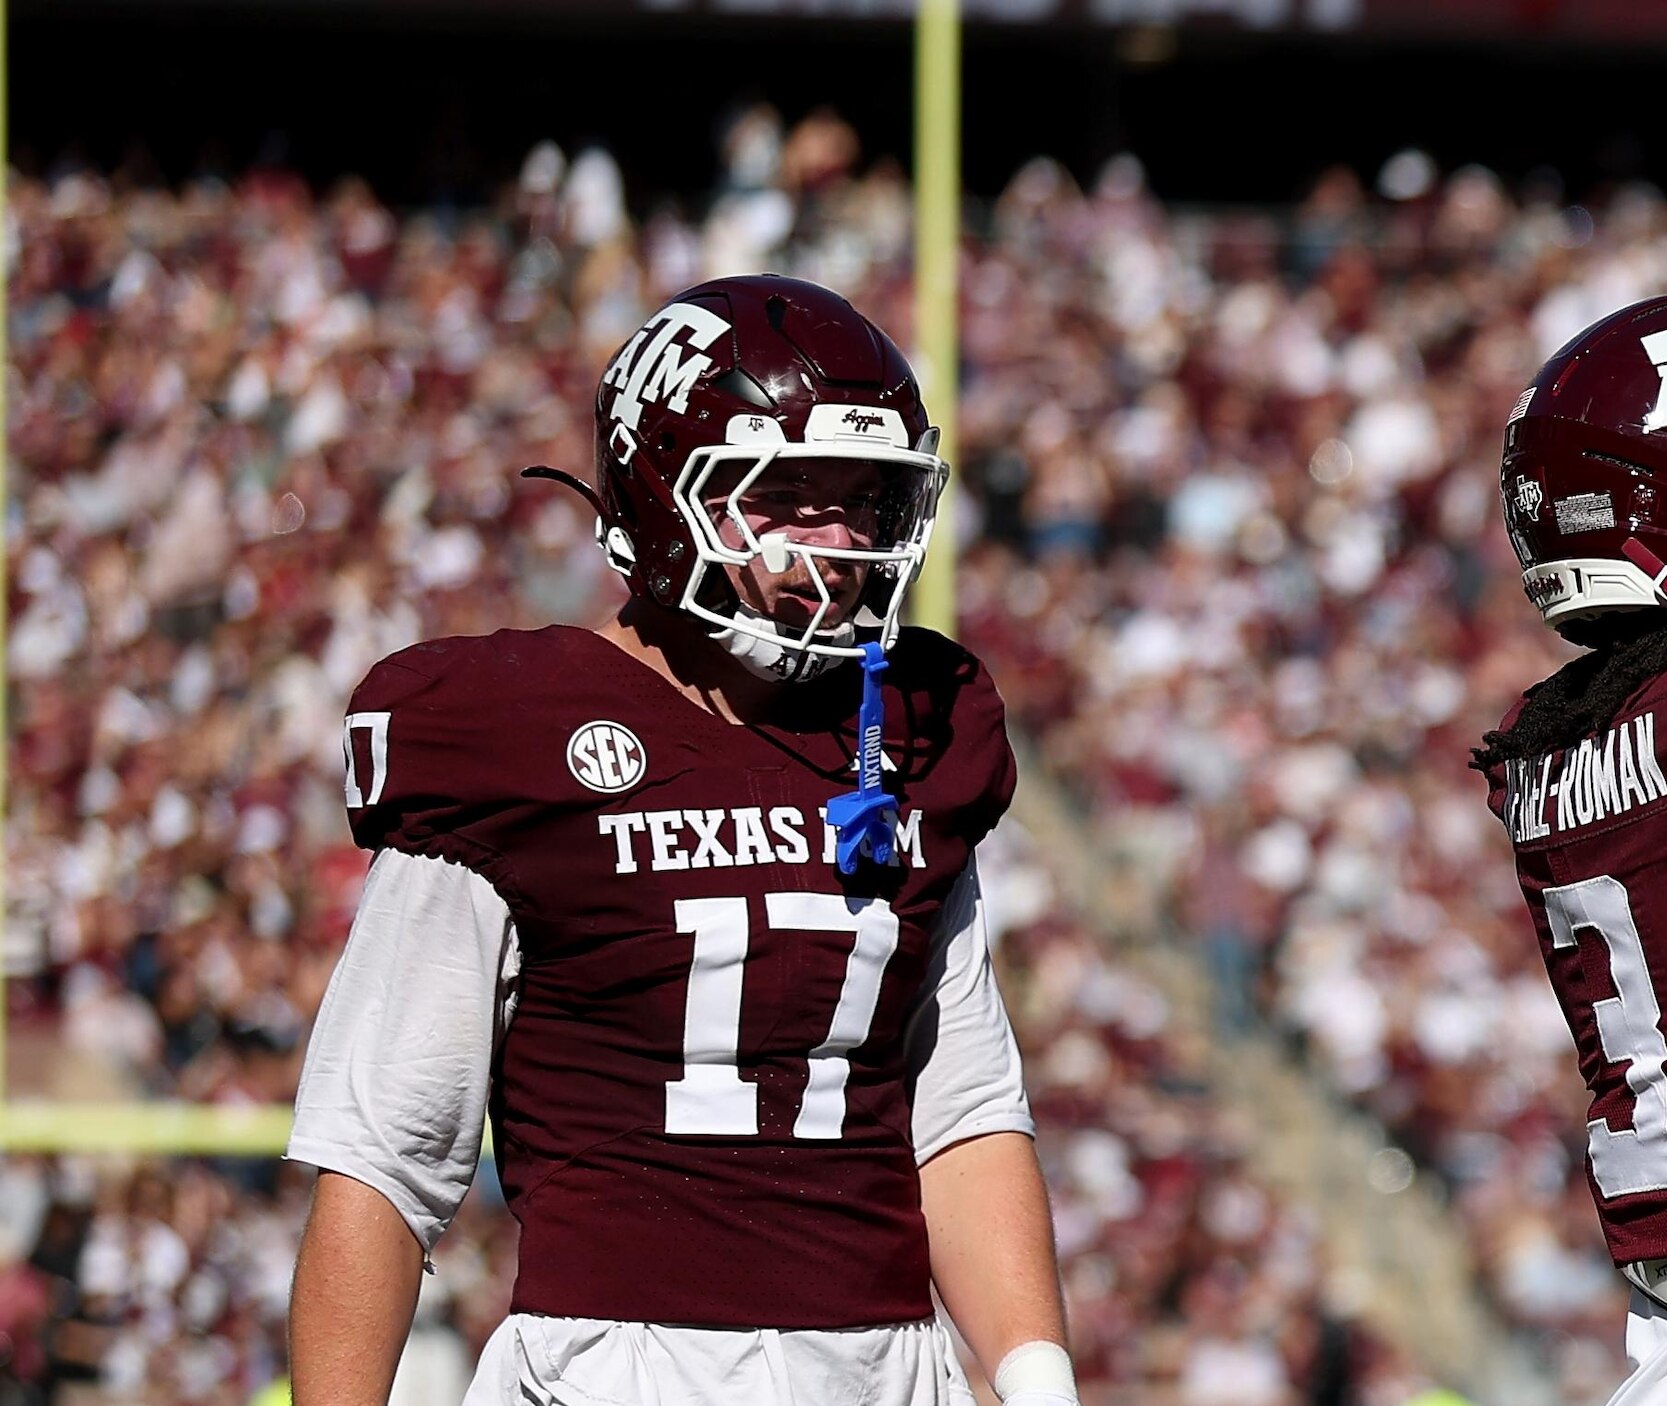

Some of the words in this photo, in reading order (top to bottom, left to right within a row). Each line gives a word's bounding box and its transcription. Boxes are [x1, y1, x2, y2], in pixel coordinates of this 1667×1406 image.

[572, 726, 642, 789] SEC
[865, 724, 882, 790] NXTRND
[598, 806, 810, 875] TEXAS
[665, 891, 900, 1140] 17
